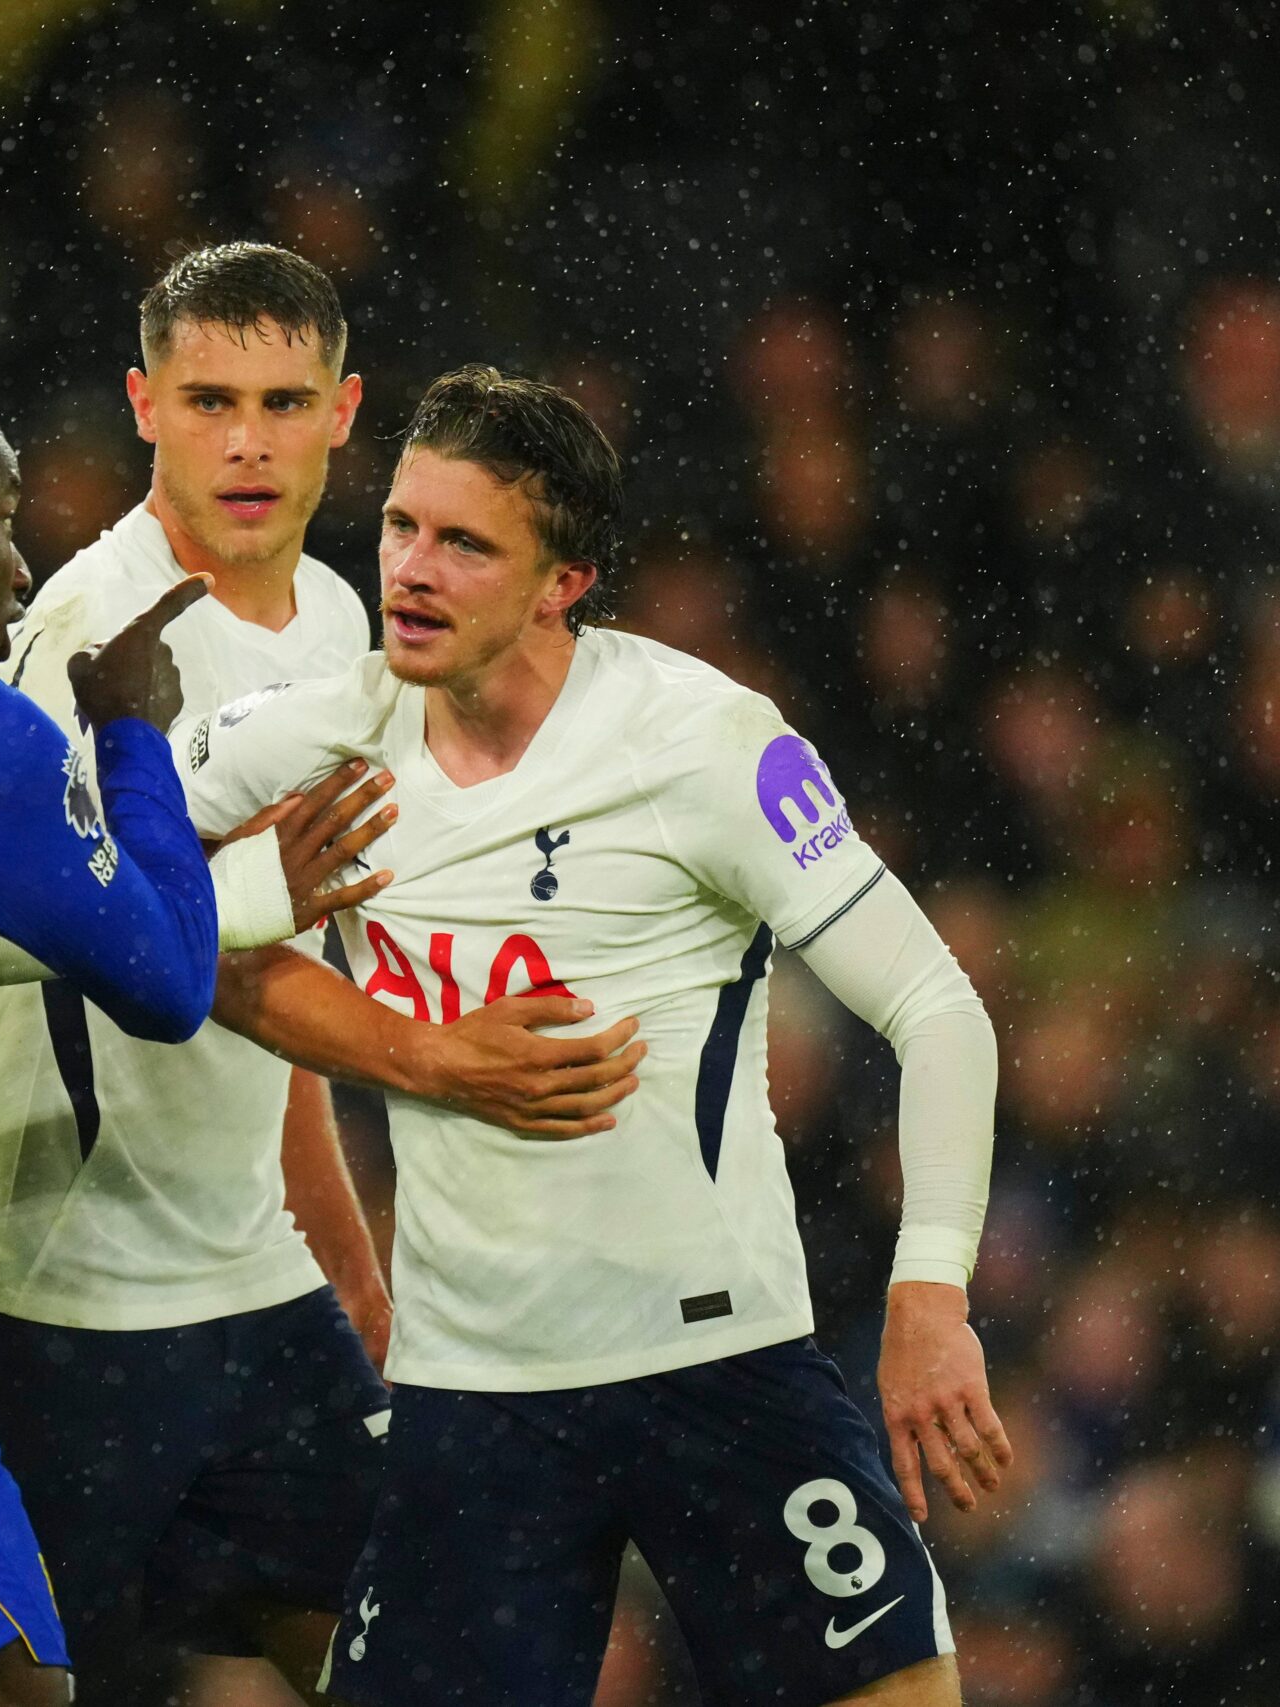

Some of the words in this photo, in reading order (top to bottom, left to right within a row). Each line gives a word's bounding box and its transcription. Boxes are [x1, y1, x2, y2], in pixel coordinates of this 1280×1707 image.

[792, 804, 851, 870] krake
[365, 920, 594, 1025] AIA
[783, 1478, 886, 1597] 8
